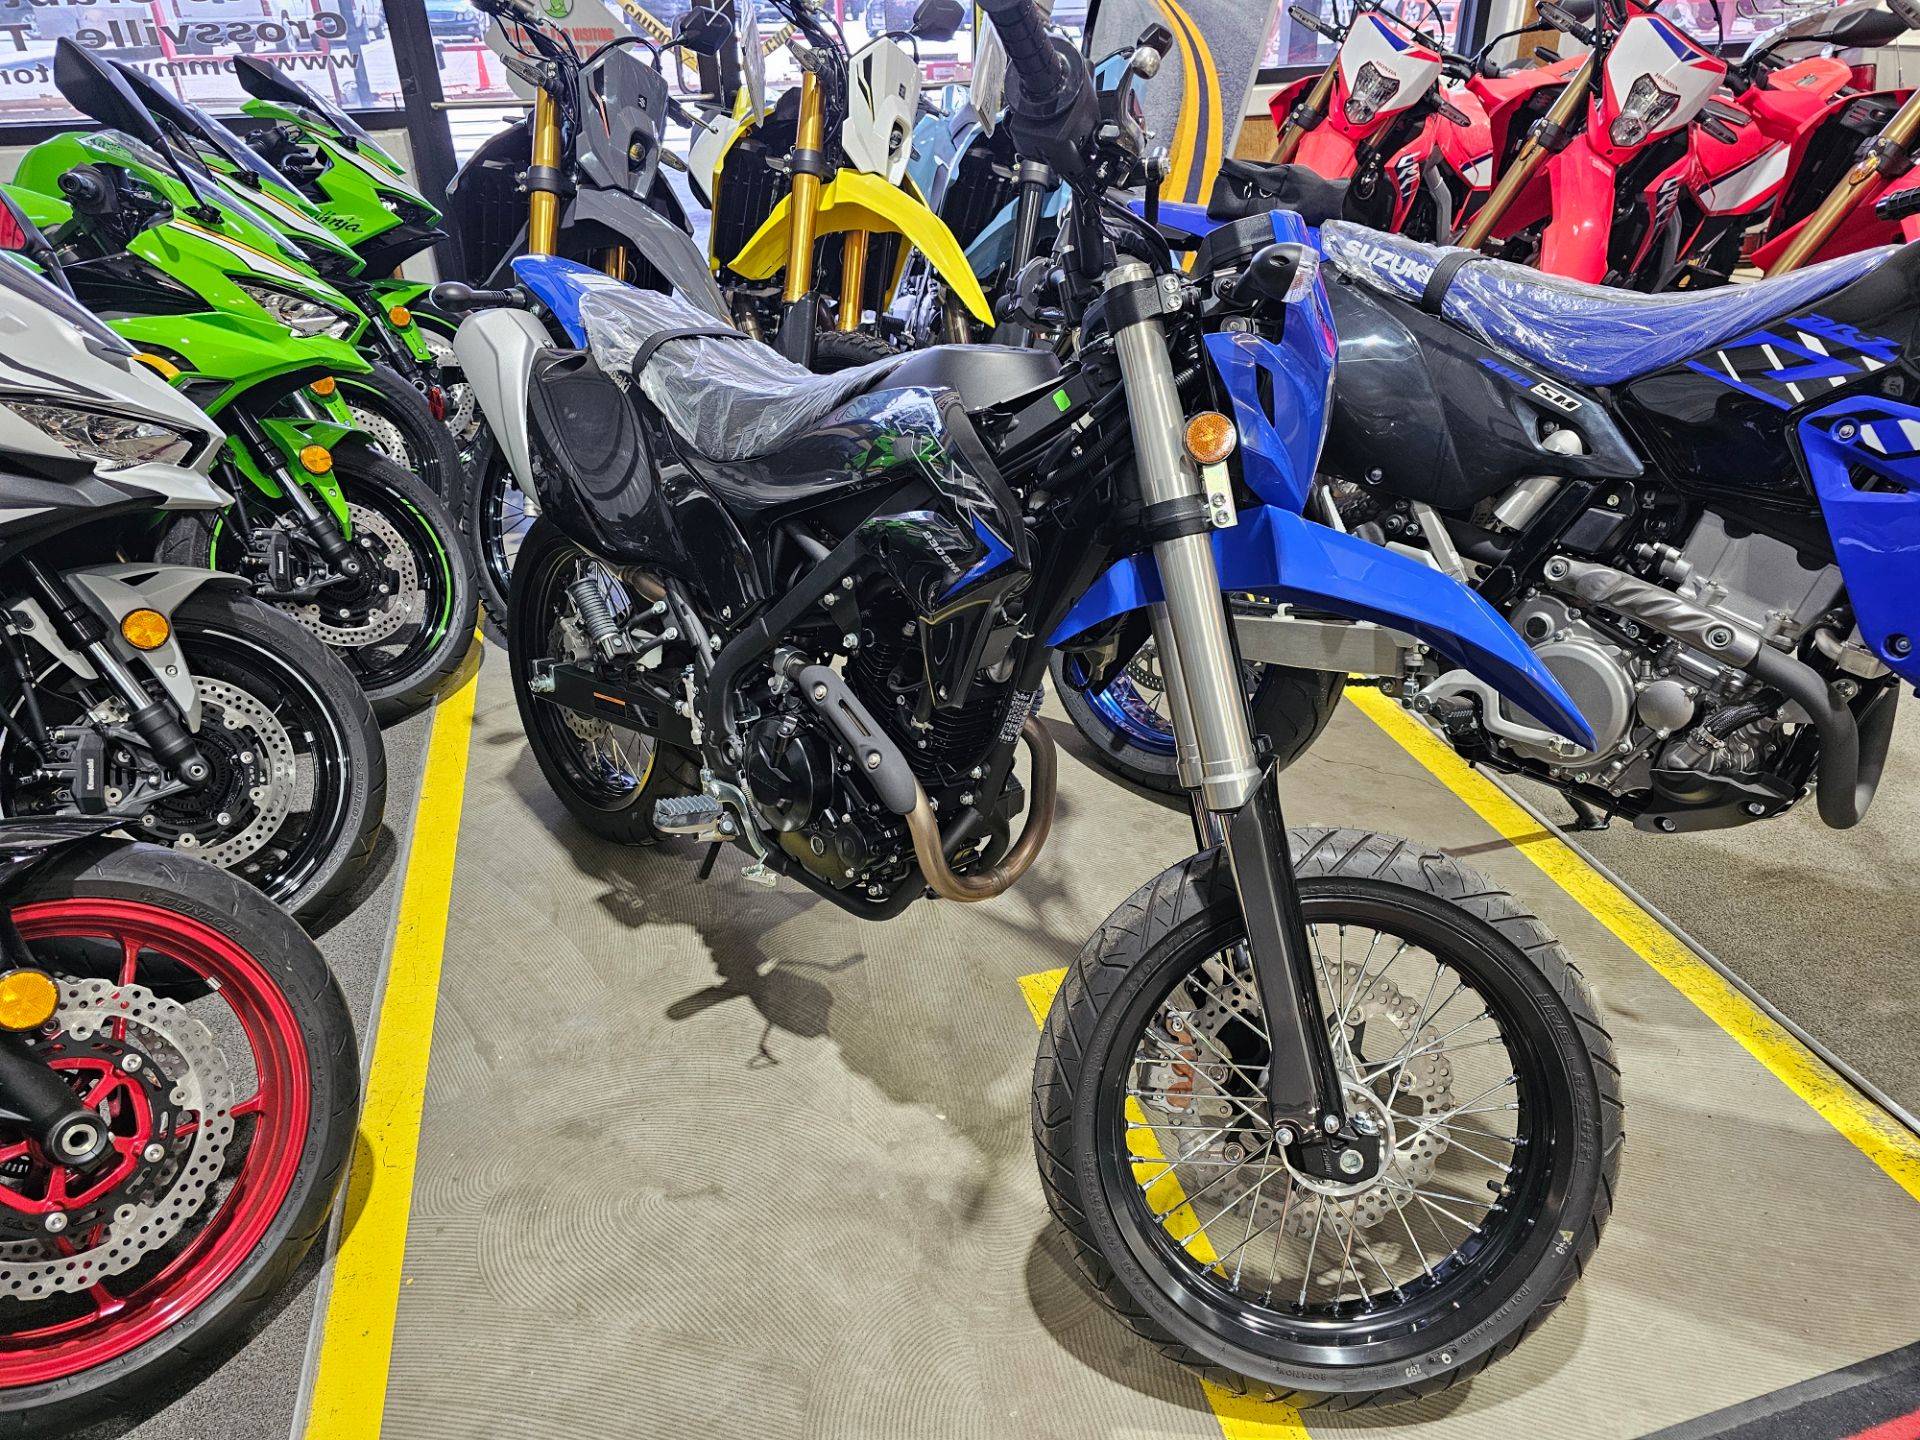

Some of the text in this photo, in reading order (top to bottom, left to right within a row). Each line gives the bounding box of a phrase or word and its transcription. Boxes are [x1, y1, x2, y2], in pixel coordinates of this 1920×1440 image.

[1376, 60, 1397, 77] HONDA
[1653, 72, 1678, 91] HONDA
[1343, 240, 1435, 285] SUZUKI
[1536, 382, 1582, 412] SM
[921, 530, 961, 575] 230SM
[158, 895, 242, 938] DUNLOP
